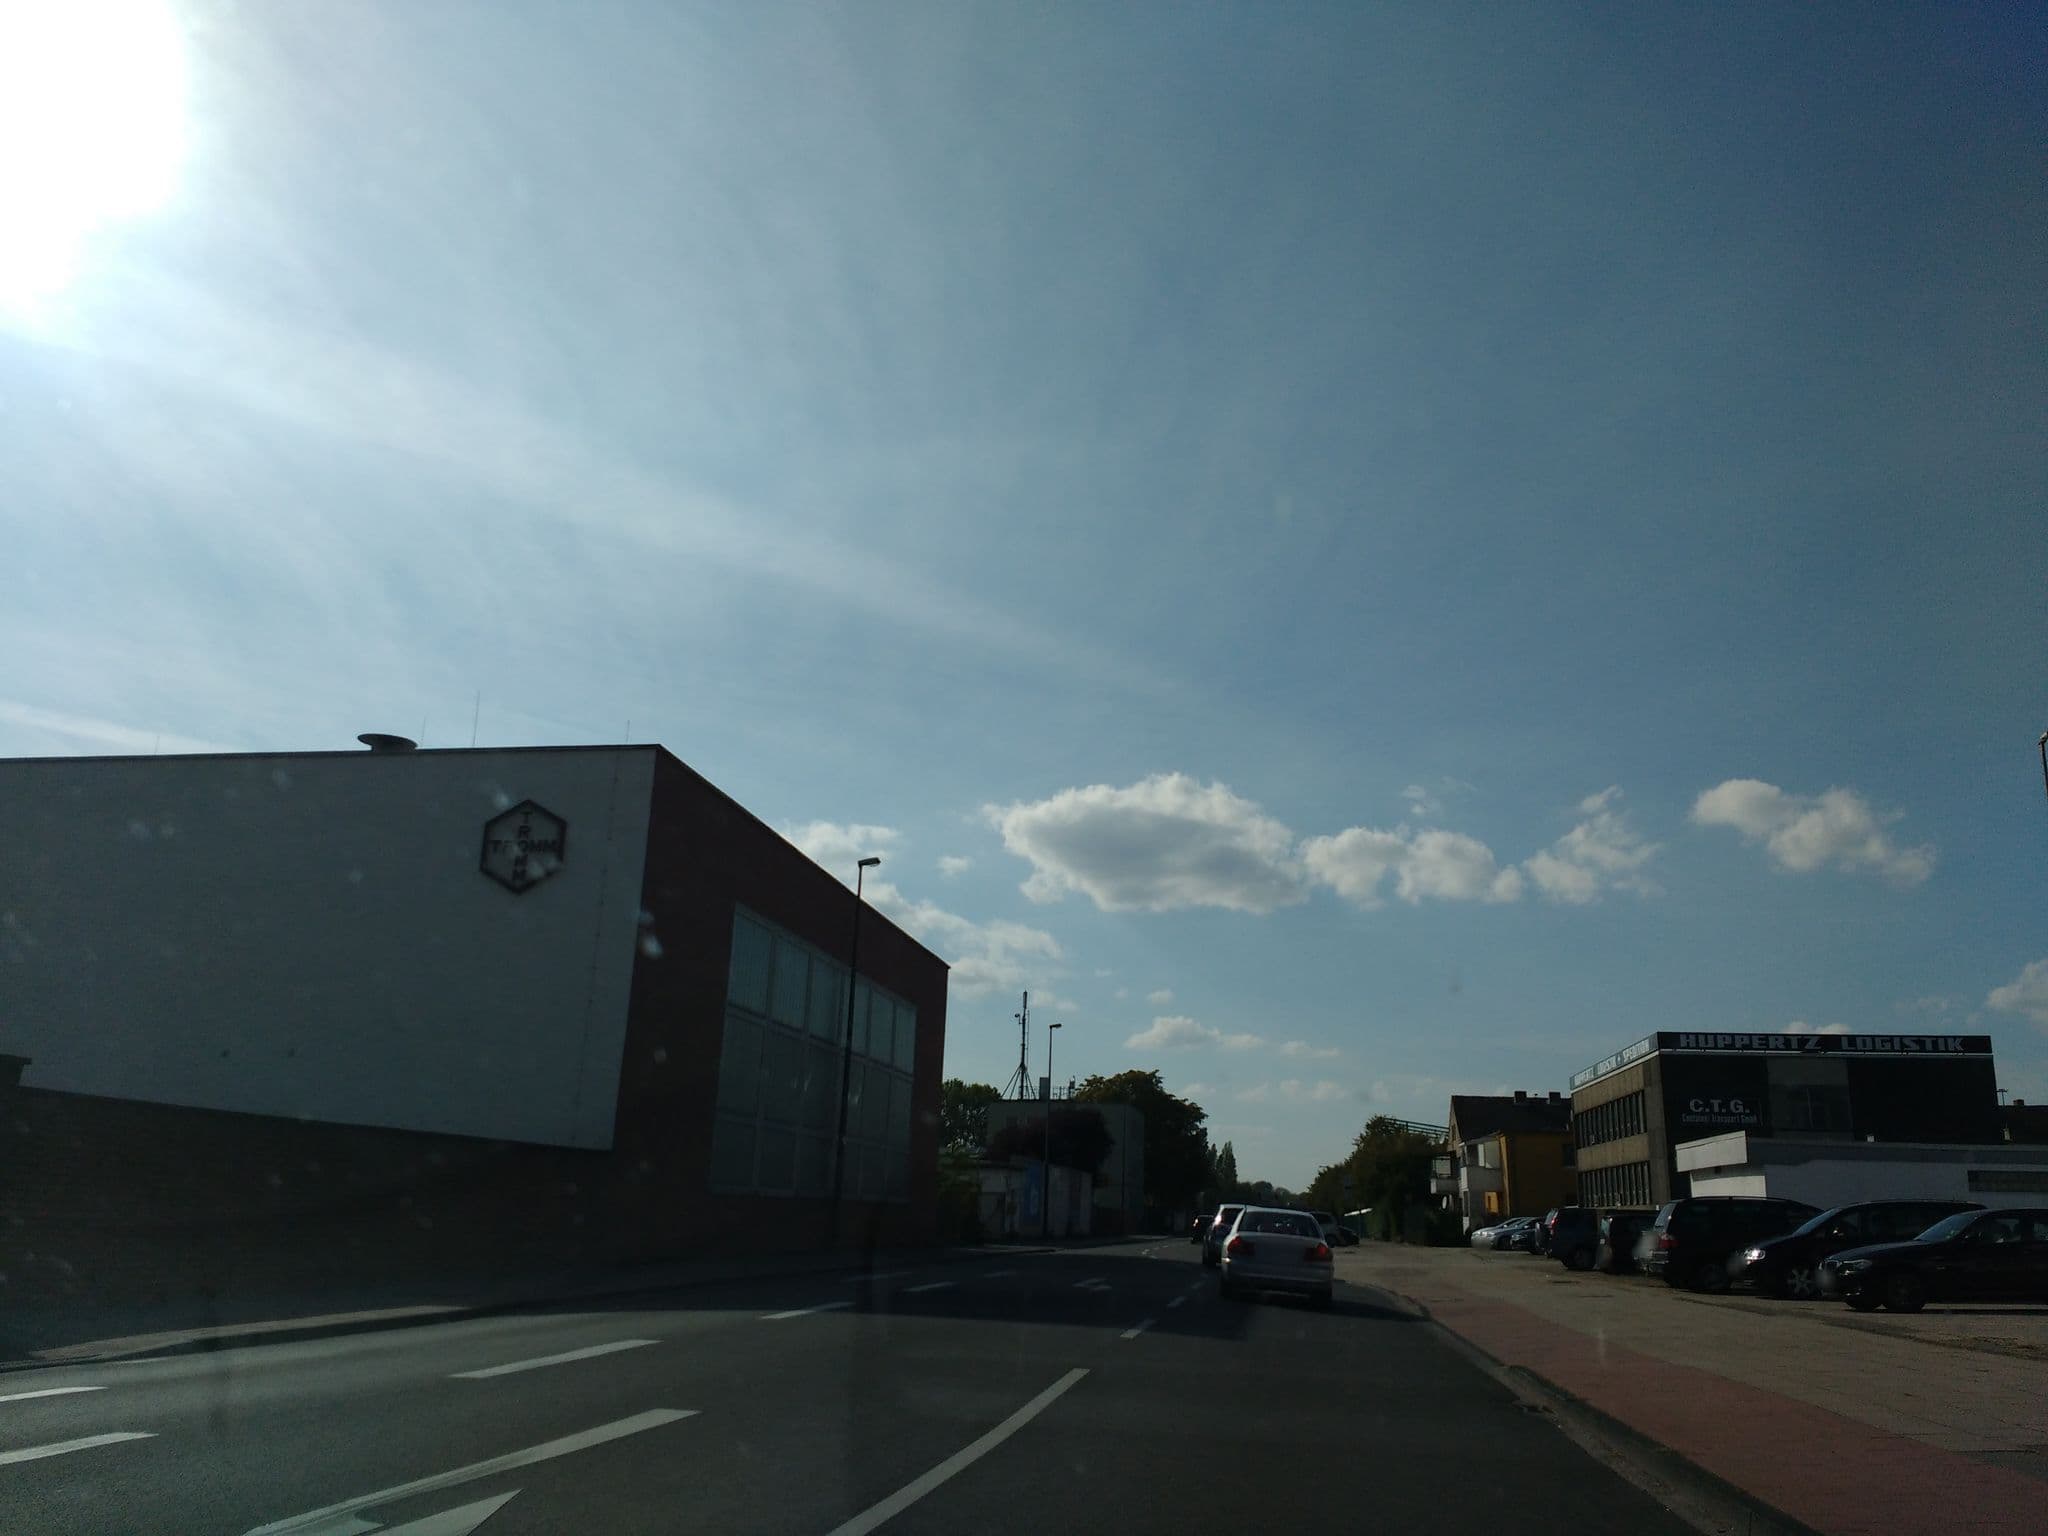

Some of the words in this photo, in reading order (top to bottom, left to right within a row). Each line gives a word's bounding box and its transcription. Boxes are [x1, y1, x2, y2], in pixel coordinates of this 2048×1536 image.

[1679, 1033, 1821, 1050] HUPPERTZ
[1840, 1035, 1966, 1052] LOGISTIK
[1689, 1098, 1751, 1113] C.T.G.
